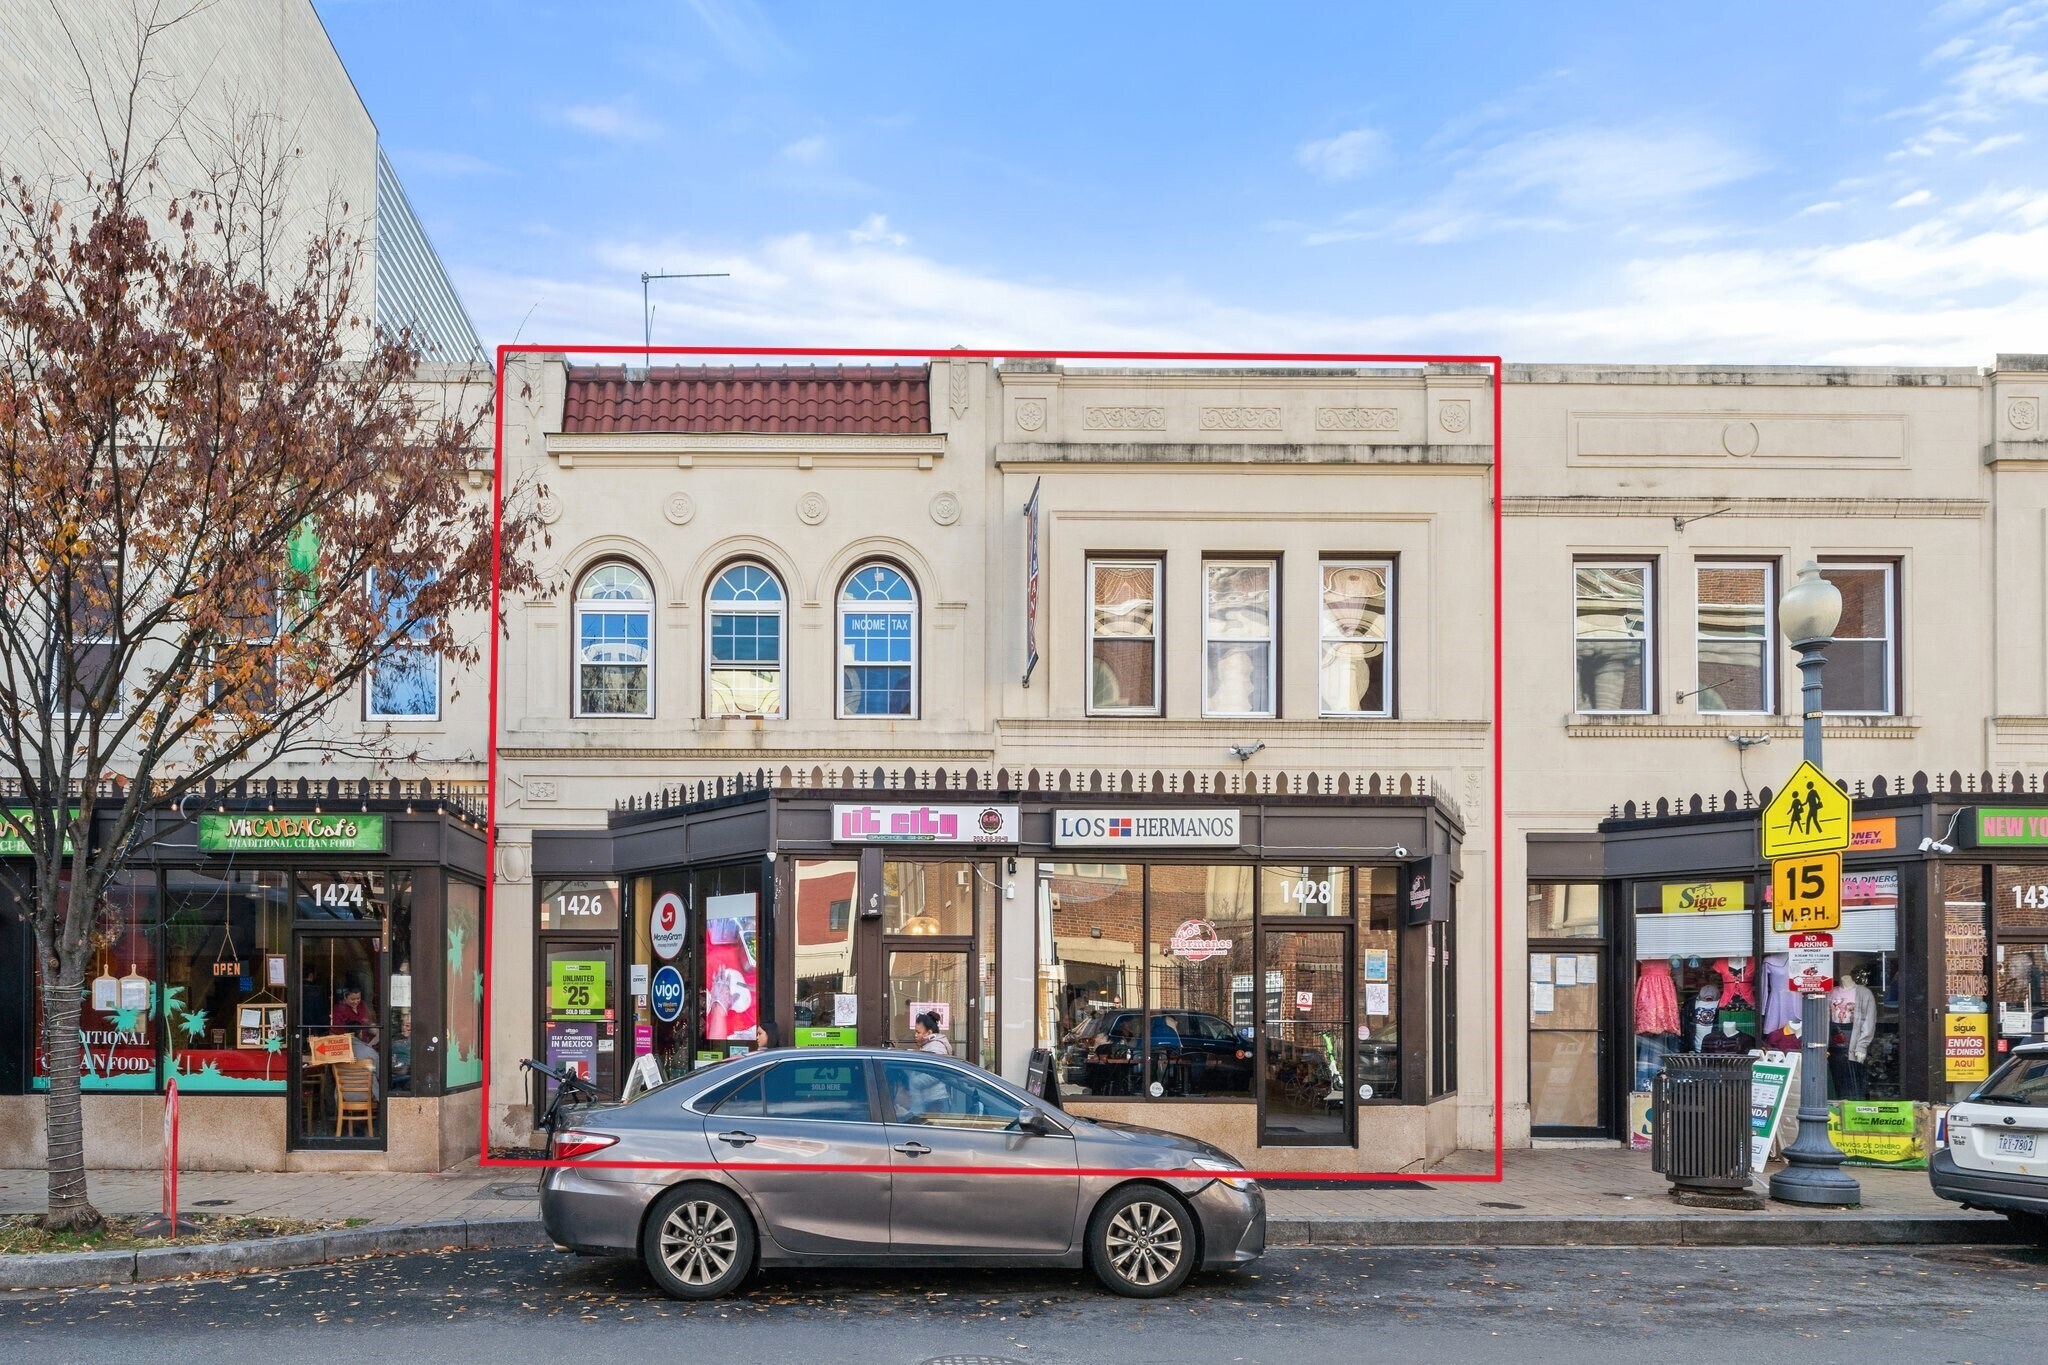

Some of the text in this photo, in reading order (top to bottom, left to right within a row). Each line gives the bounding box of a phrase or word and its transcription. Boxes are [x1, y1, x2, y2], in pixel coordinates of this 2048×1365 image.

[852, 619, 908, 630] INCOME TAX
[1061, 817, 1234, 837] LOS HERMANOS
[1983, 816, 2024, 837] NEW
[228, 839, 355, 848] TRADITIONAL CUBAN FOOD
[1786, 864, 1825, 901] 15
[312, 883, 364, 907] 1424
[1280, 880, 1331, 904] 1428
[557, 895, 602, 916] 1426
[1679, 886, 1727, 912] Sigue
[1782, 906, 1830, 922] M.P.H.
[1946, 923, 1983, 936] PAGO DE
[653, 932, 682, 942] MoneyGram
[1171, 938, 1233, 949] Hermanos
[213, 963, 240, 976] OPEN
[1946, 959, 1984, 970] TARJETAS
[562, 985, 590, 1006] $25
[655, 981, 680, 1000] vigo
[1953, 1023, 1977, 1034] sigue
[1947, 1037, 1983, 1048] ENVÍOS
[1946, 1048, 1985, 1057] DE DINERO
[106, 1056, 150, 1071] FOOD
[1954, 1059, 1976, 1068] AQUÍ
[1752, 1070, 1785, 1081] termex
[1870, 1117, 1906, 1126] Mexico!
